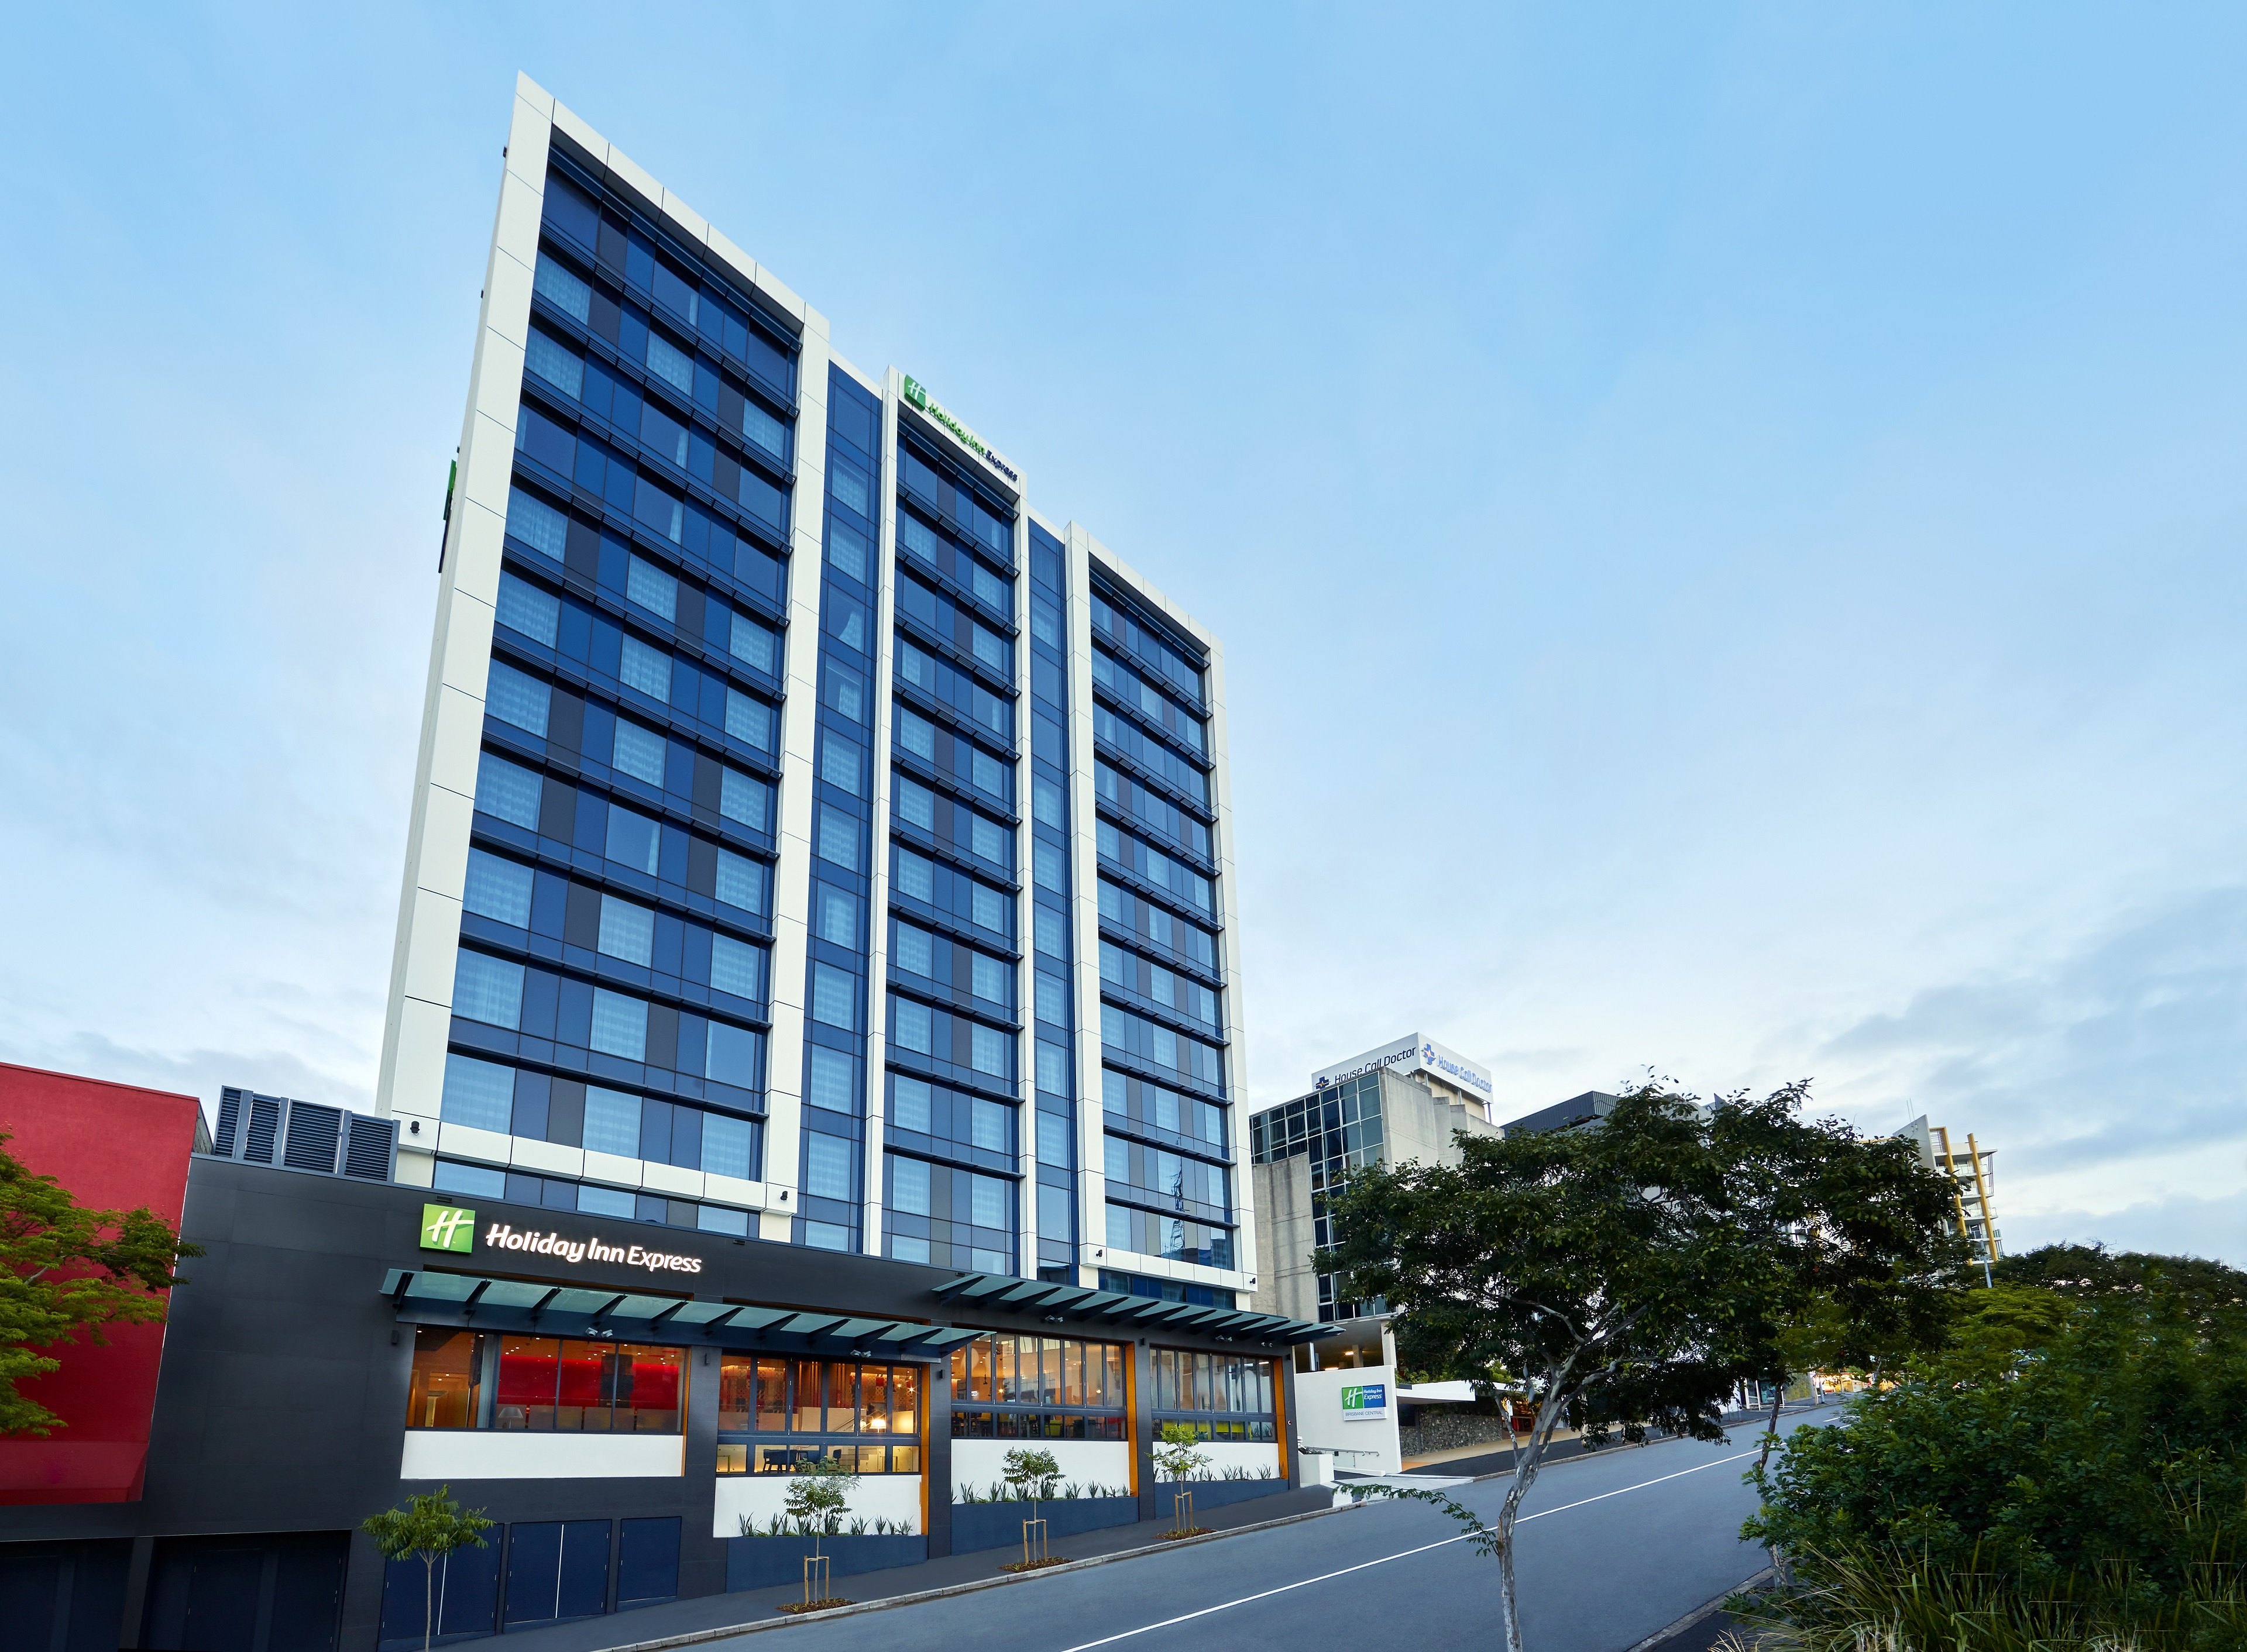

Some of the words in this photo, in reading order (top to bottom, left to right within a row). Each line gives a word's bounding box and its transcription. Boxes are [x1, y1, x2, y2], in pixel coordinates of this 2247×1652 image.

[929, 402, 969, 445] Holiday
[969, 435, 985, 455] Inn
[986, 449, 1018, 481] Express
[1335, 1068, 1363, 1084] House
[1365, 1058, 1382, 1073] Call
[1383, 1047, 1416, 1067] Doctor
[1437, 1055, 1459, 1075] House
[1459, 1066, 1471, 1082] Call
[1471, 1072, 1492, 1093] Doctor
[485, 1223, 586, 1263] Holiday
[587, 1237, 626, 1263] Inn
[627, 1246, 703, 1273] Express
